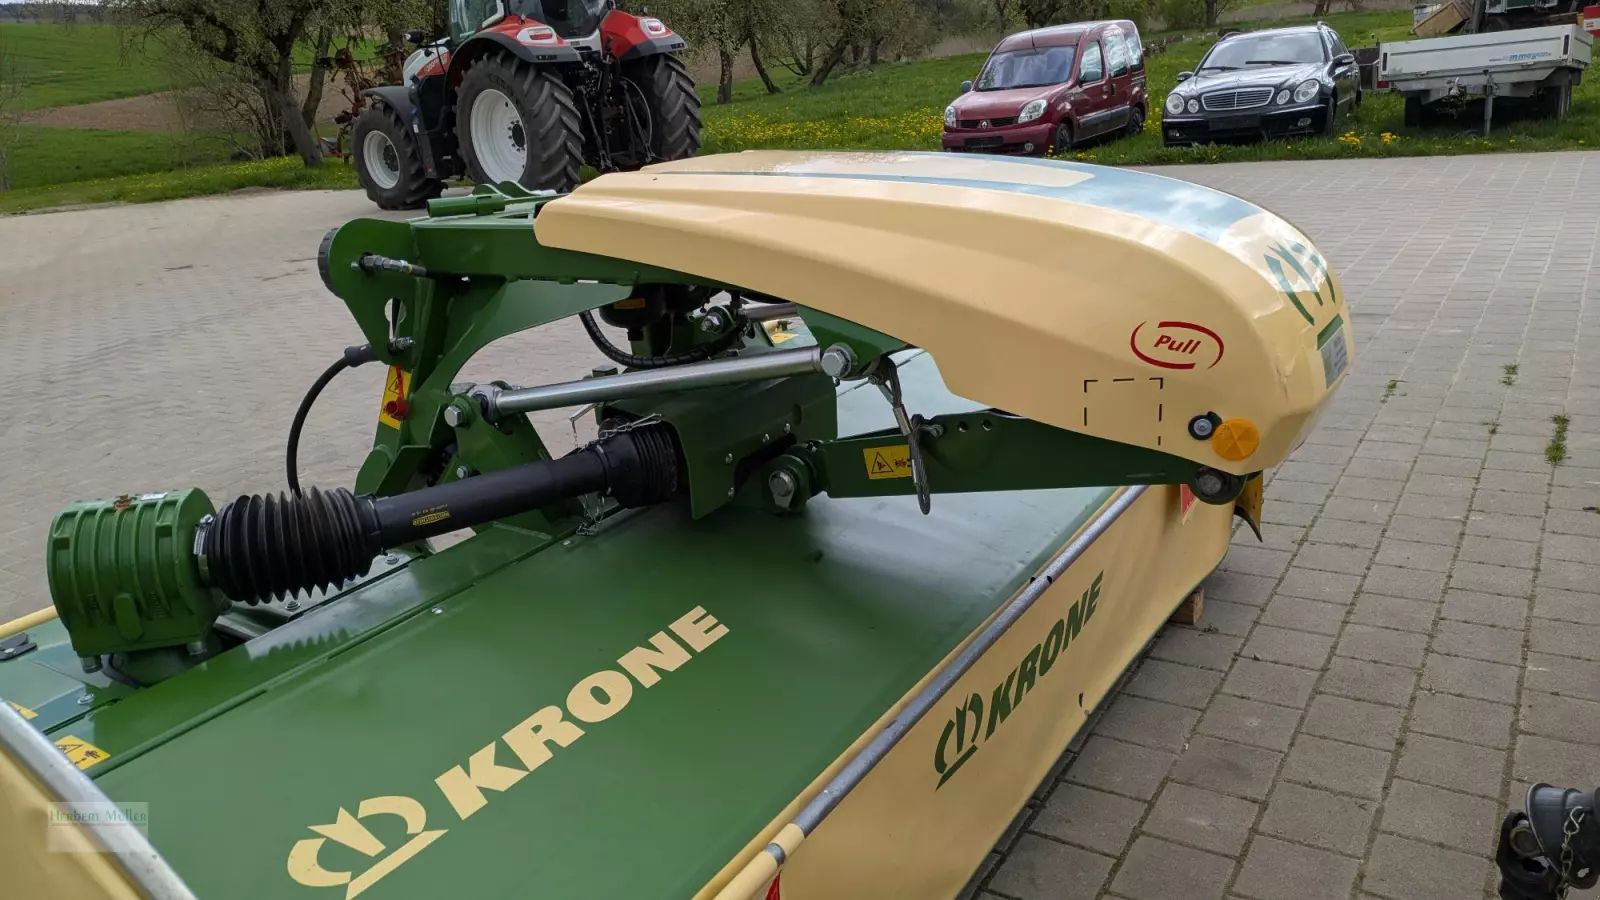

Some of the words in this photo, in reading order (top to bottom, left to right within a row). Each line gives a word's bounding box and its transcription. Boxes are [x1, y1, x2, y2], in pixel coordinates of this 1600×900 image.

[1153, 334, 1202, 354] Pull
[434, 605, 730, 820] KRONE
[985, 569, 1104, 743] KRONE
